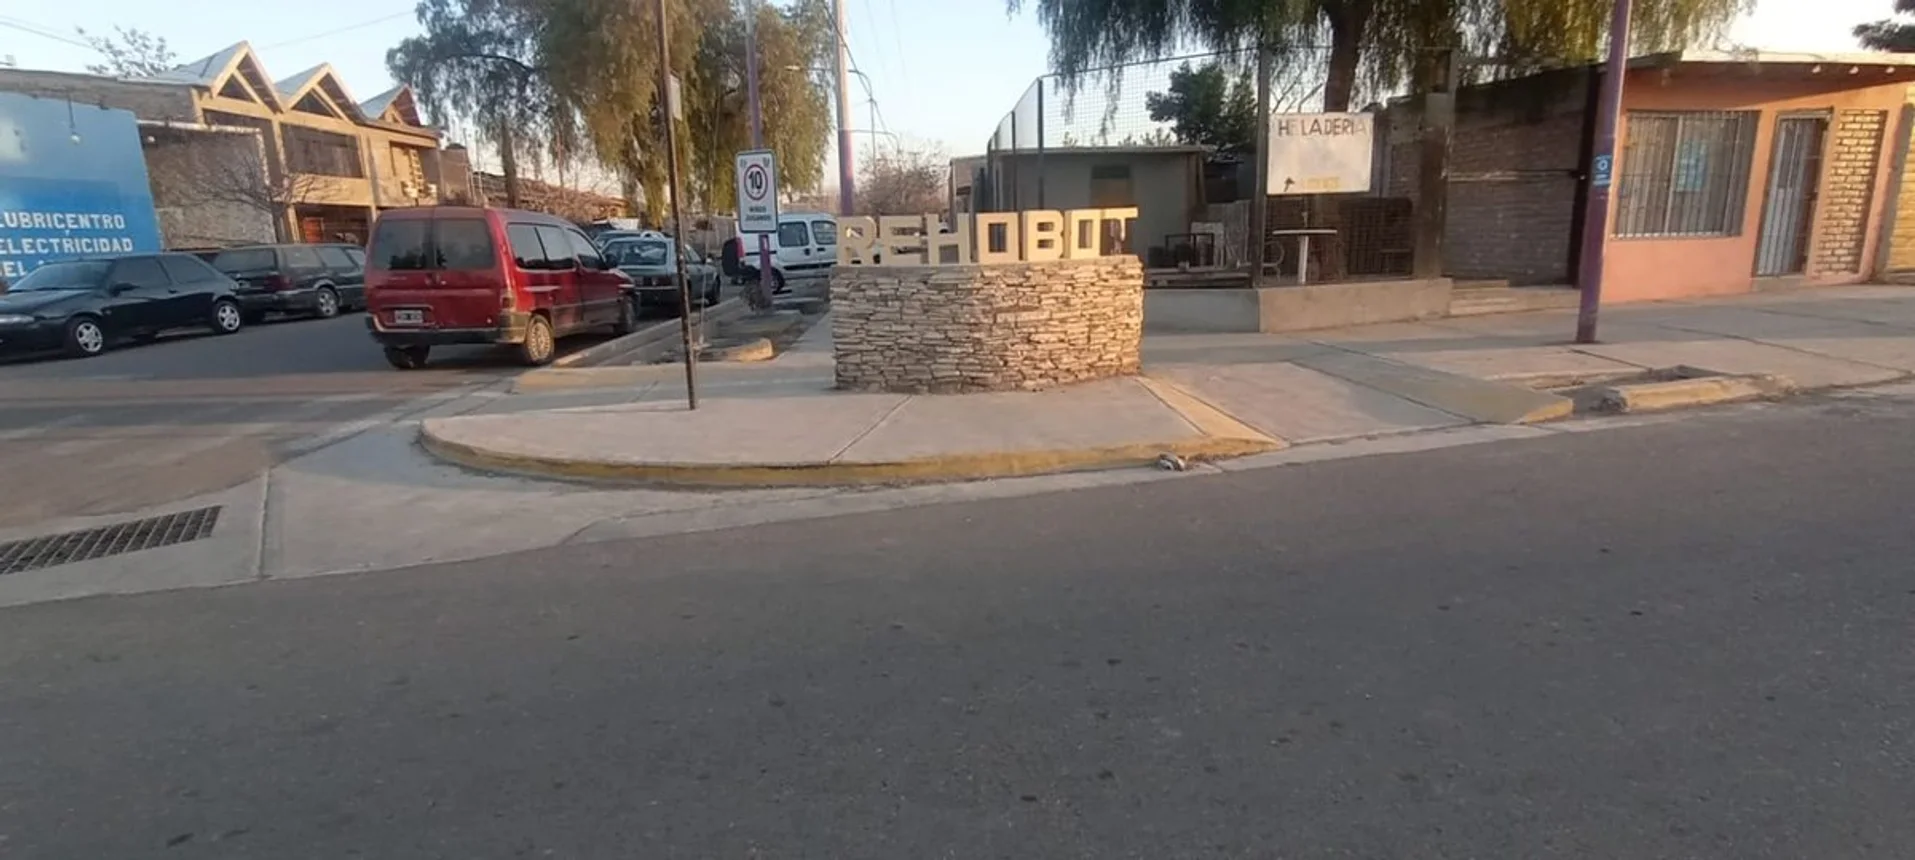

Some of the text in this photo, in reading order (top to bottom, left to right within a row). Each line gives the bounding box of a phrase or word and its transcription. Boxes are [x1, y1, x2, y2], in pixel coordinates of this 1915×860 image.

[748, 171, 762, 189] 10
[835, 206, 1139, 266] REHOBOT
[0, 259, 28, 278] EL
